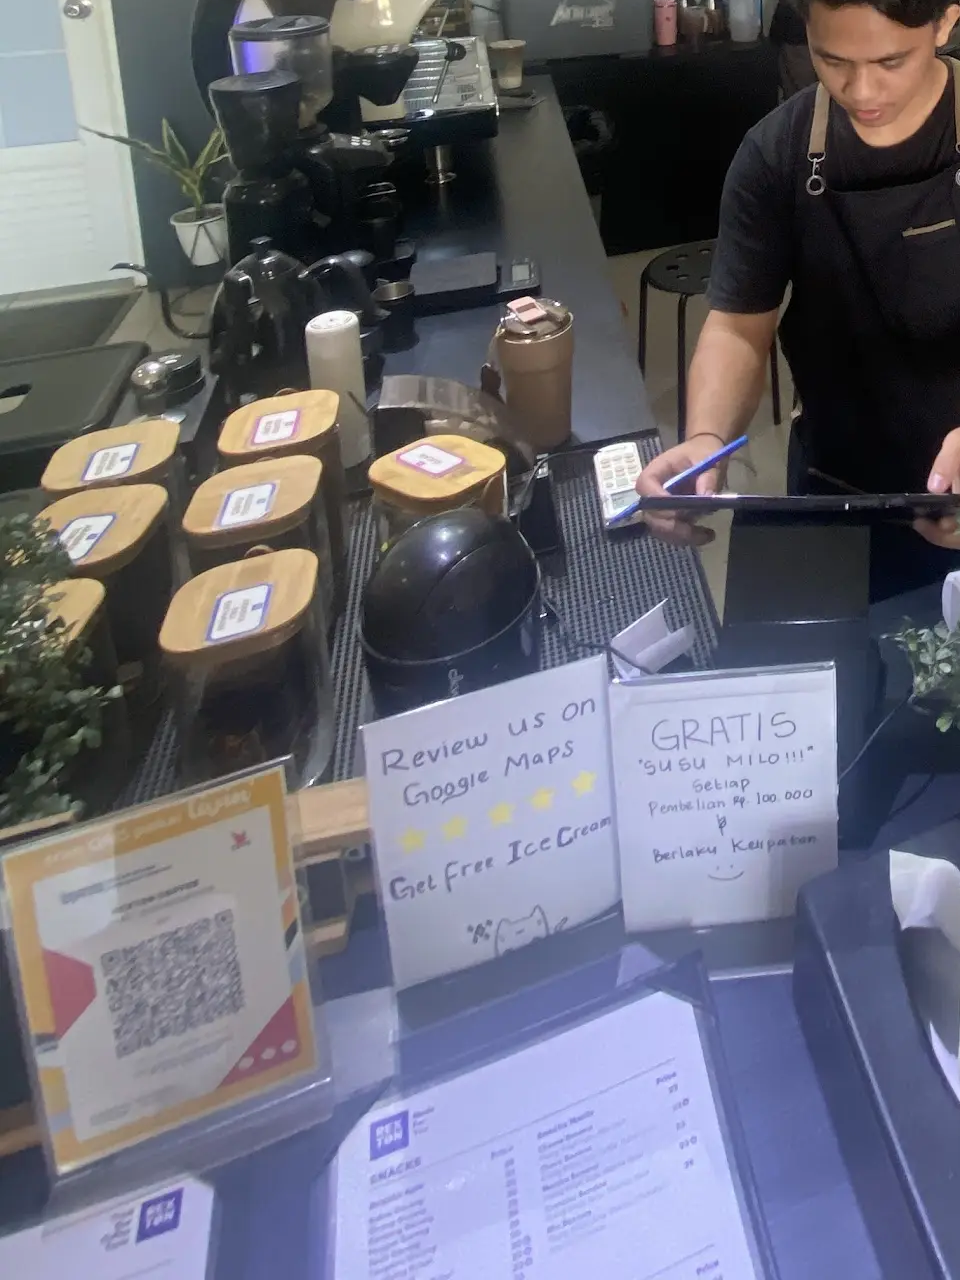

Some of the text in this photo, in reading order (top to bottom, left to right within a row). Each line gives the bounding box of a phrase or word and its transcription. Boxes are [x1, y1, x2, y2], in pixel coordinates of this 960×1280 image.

[381, 698, 595, 776] Review us on
[651, 712, 797, 750] GRATIS
[403, 770, 489, 806] Google
[648, 799, 726, 817] Pembelian
[389, 874, 437, 901] Get
[507, 836, 551, 866] Ice
[556, 816, 611, 848] Cream
[653, 847, 717, 864] Berlaku
